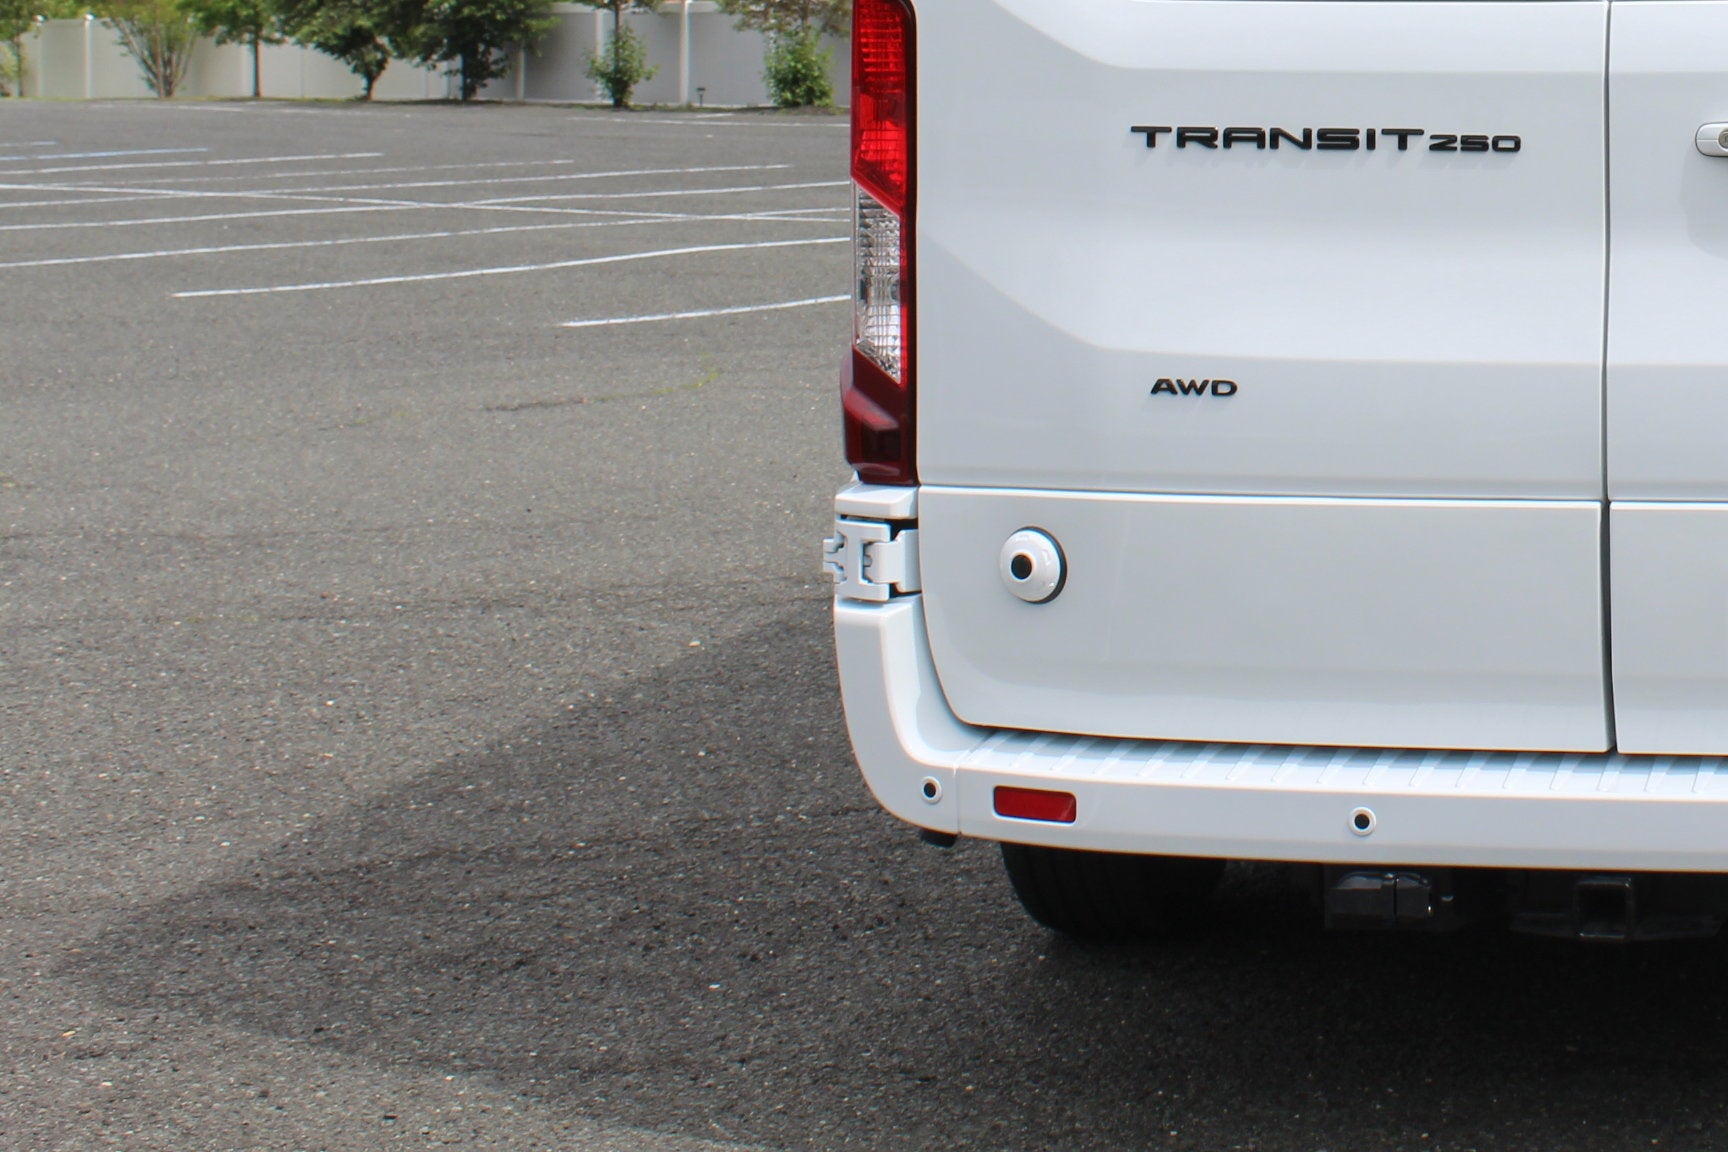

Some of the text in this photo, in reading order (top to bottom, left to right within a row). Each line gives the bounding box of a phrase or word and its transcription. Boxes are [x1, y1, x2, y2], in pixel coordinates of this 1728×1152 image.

[1130, 125, 1522, 152] TRANSIT 250
[1150, 378, 1238, 397] AWD
